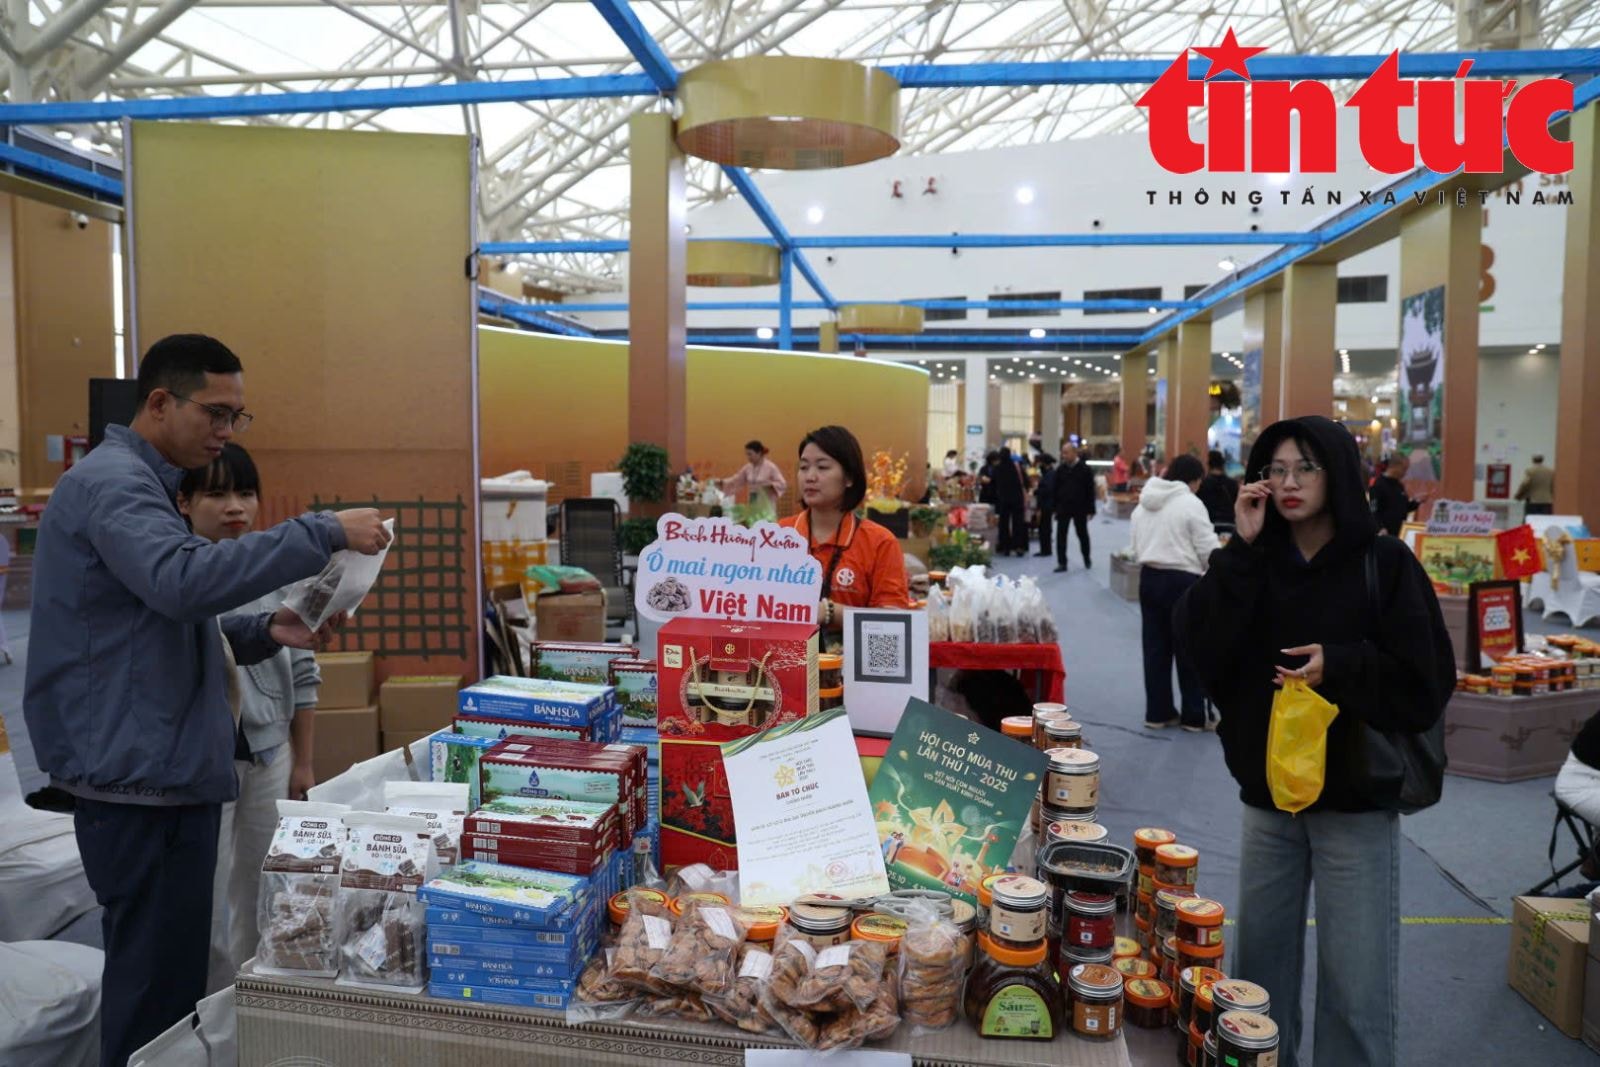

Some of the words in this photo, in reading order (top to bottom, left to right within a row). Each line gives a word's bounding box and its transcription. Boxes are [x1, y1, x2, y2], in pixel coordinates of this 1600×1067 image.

[664, 520, 708, 542] Bách
[759, 528, 800, 549] Xuân
[667, 556, 706, 576] mai
[711, 562, 763, 584] ngon
[767, 561, 816, 585] nhất
[699, 588, 747, 621] Việt
[756, 593, 811, 622] Nam
[533, 702, 560, 715] BÁNH
[561, 705, 580, 718] SỮA
[920, 731, 940, 748] HỘI
[942, 741, 966, 758] CHỢ
[967, 751, 992, 770] MÙA
[995, 763, 1017, 781] THU
[917, 745, 939, 762] LẦN
[941, 754, 964, 772] THỨ
[964, 765, 970, 775] I
[980, 772, 1008, 793] 2025
[956, 779, 967, 789] CON
[776, 791, 790, 800] BAN
[293, 829, 315, 838] BÁNH
[317, 831, 332, 839] SỮA
[366, 843, 391, 852] BÁNH
[393, 844, 407, 854] SỮA
